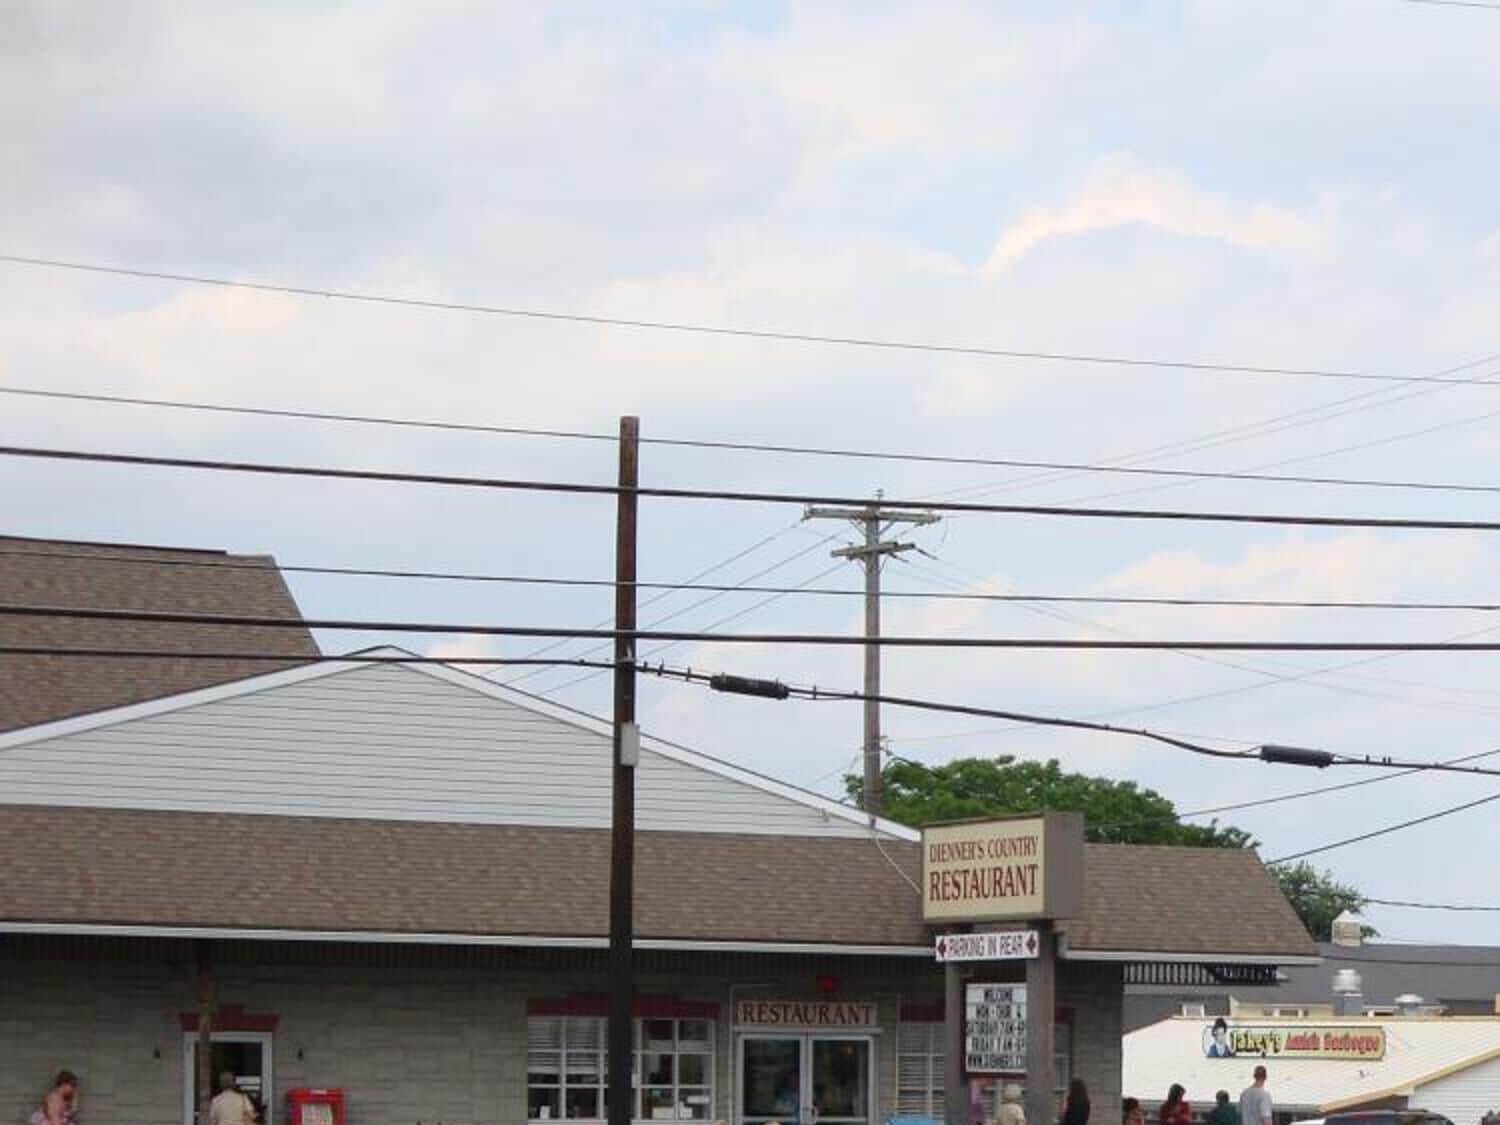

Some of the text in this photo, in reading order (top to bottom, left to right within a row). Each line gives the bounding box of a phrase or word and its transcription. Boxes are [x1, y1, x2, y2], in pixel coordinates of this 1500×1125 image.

[929, 835, 1039, 863] DIENNER'S COUNTRY
[929, 863, 1039, 902] RESTAURANT
[948, 934, 1024, 958] PARKING IN REAR
[742, 1003, 874, 1025] RESTAURANT
[1230, 1031, 1281, 1058] Jakey's
